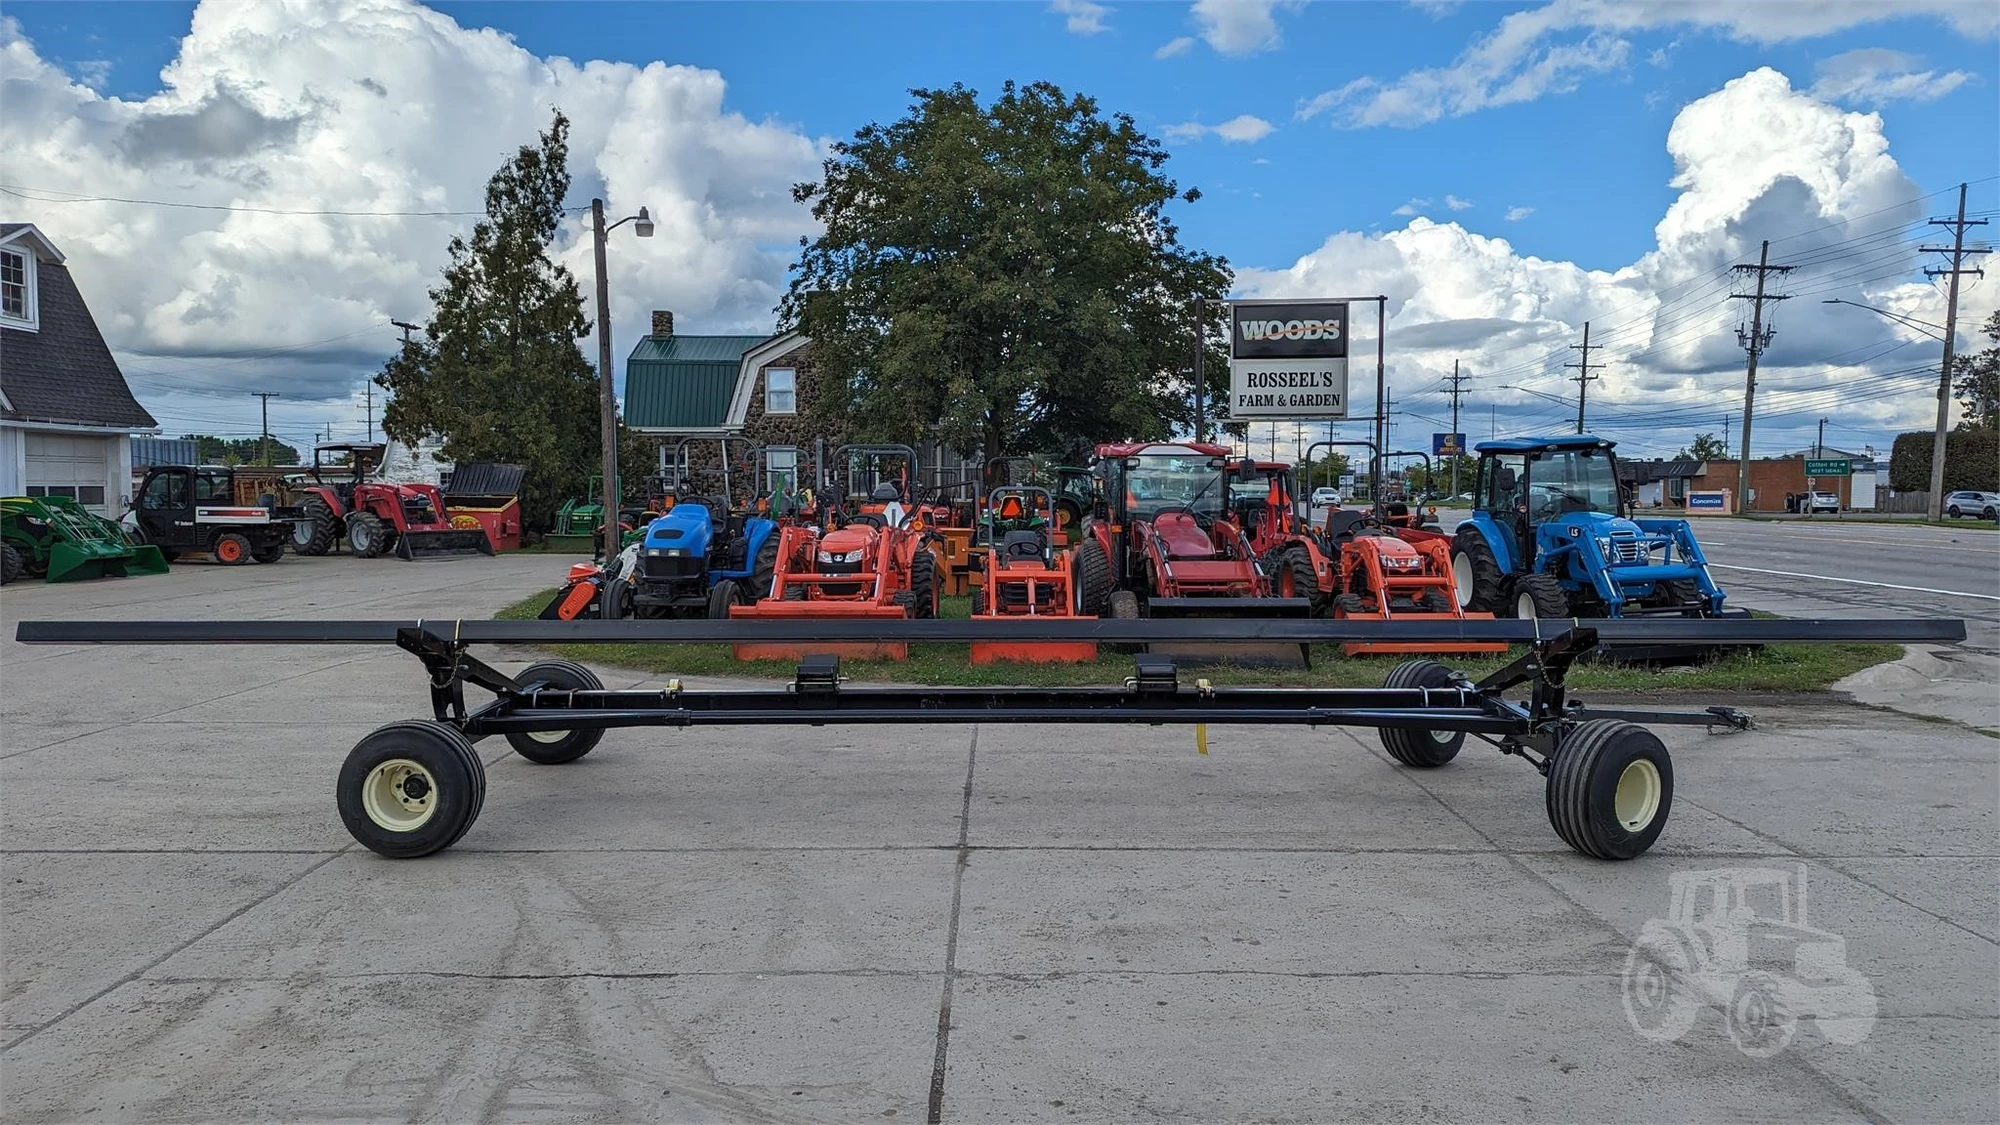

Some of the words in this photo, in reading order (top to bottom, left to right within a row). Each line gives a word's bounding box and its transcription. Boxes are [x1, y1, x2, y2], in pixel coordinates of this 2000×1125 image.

[1240, 320, 1340, 340] WOODS
[1247, 372, 1333, 387] ROSSEEL'S
[1239, 395, 1274, 406] FARM
[1277, 394, 1287, 406] &
[1290, 394, 1340, 406] GARDEN
[1571, 528, 1578, 536] LS
